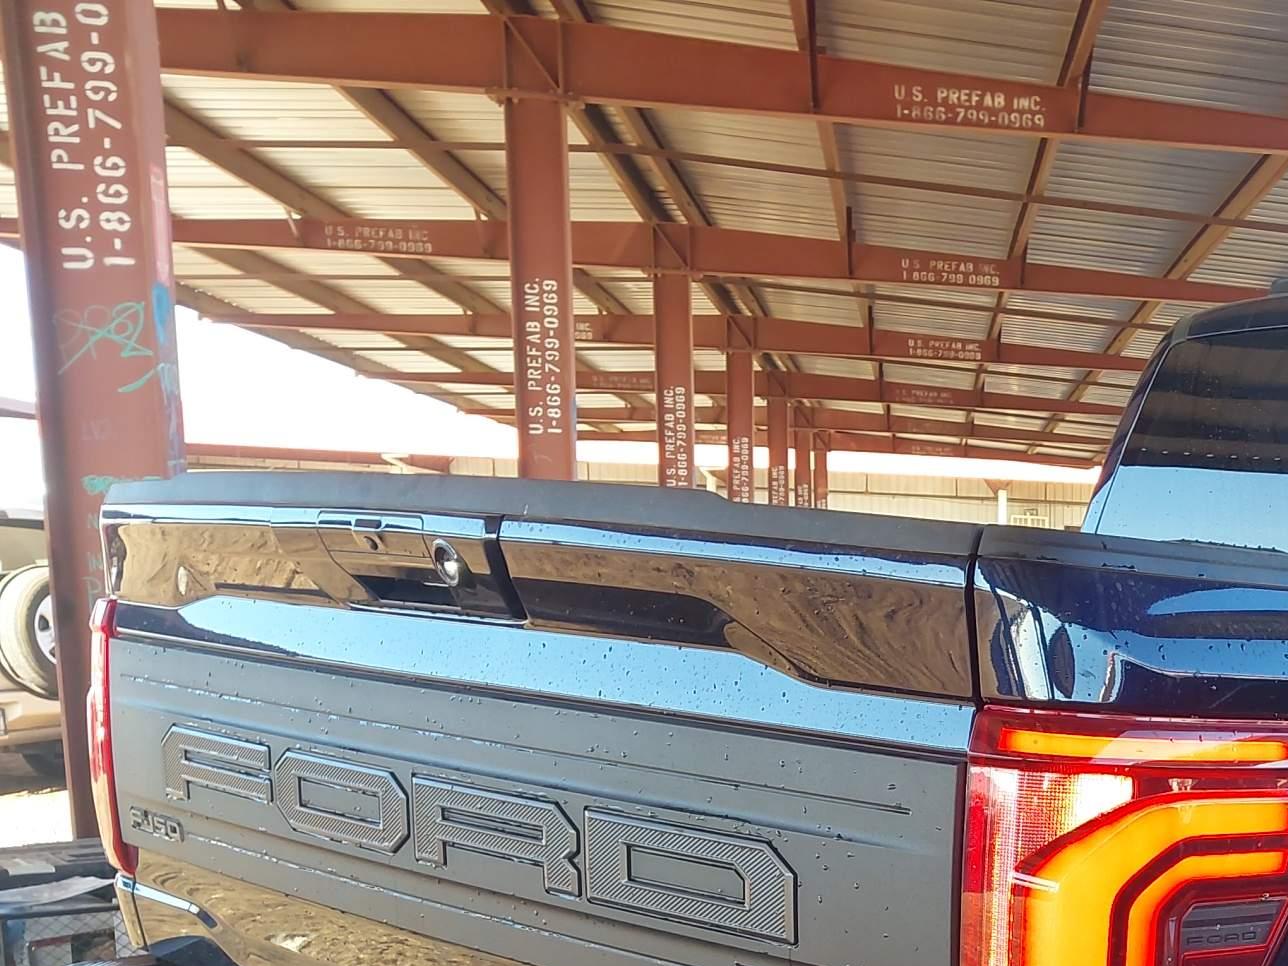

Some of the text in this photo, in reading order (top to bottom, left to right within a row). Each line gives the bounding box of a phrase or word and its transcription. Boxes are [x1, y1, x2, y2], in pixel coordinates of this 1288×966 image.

[896, 103, 1045, 129] 1-866-799-0969
[937, 87, 1006, 109] PREFAB
[1012, 95, 1046, 112] INC.
[33, 10, 95, 269] U.S. PREFAB
[929, 259, 974, 272] PREFAB
[524, 278, 544, 434] U.S. PREFAB INC.
[542, 279, 562, 434] 1-866-799-0969
[664, 413, 676, 459] PREFAB
[161, 722, 798, 947] FORD
[1186, 931, 1256, 945] FORD
